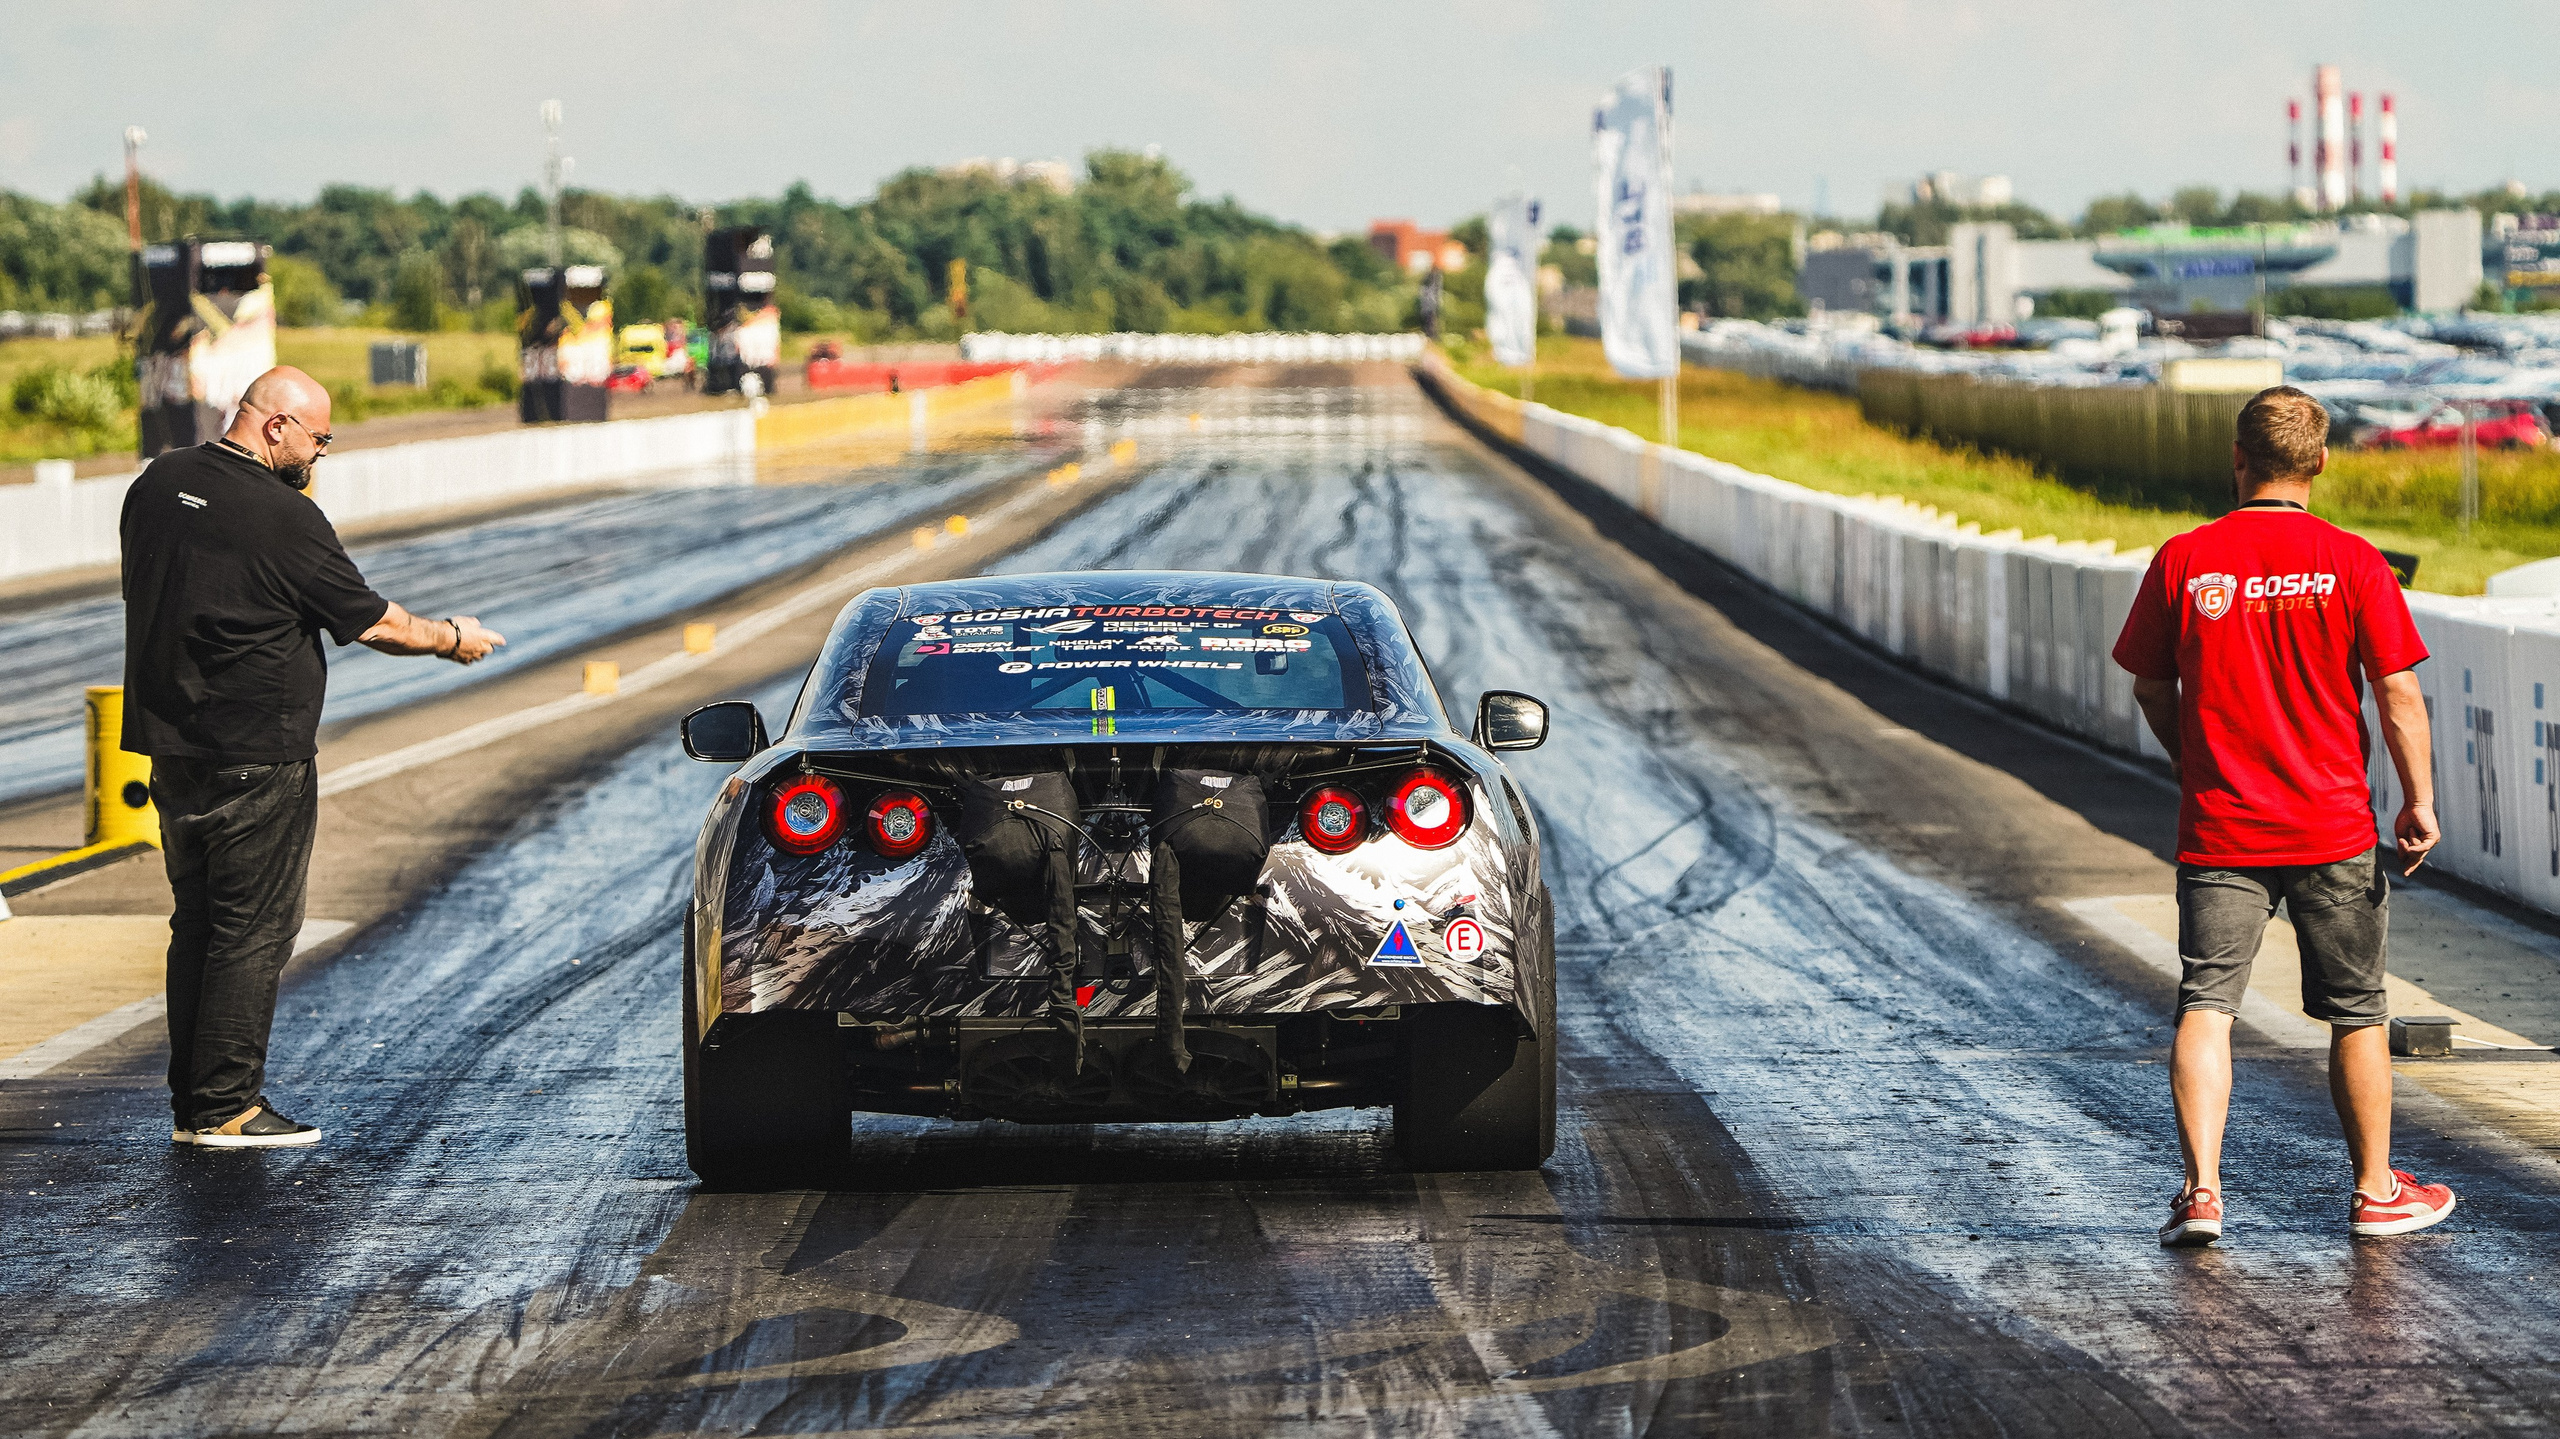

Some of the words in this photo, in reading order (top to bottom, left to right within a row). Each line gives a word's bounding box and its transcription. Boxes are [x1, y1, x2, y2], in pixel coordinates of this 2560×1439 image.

[2245, 572, 2336, 598] GOSHA
[2205, 589, 2222, 609] G
[2245, 596, 2330, 613] TURBOTEH
[952, 645, 1046, 654] EXHAUST
[1037, 661, 1131, 669] POWER
[1138, 661, 1243, 669] WHEELS
[1458, 927, 1471, 950] E
